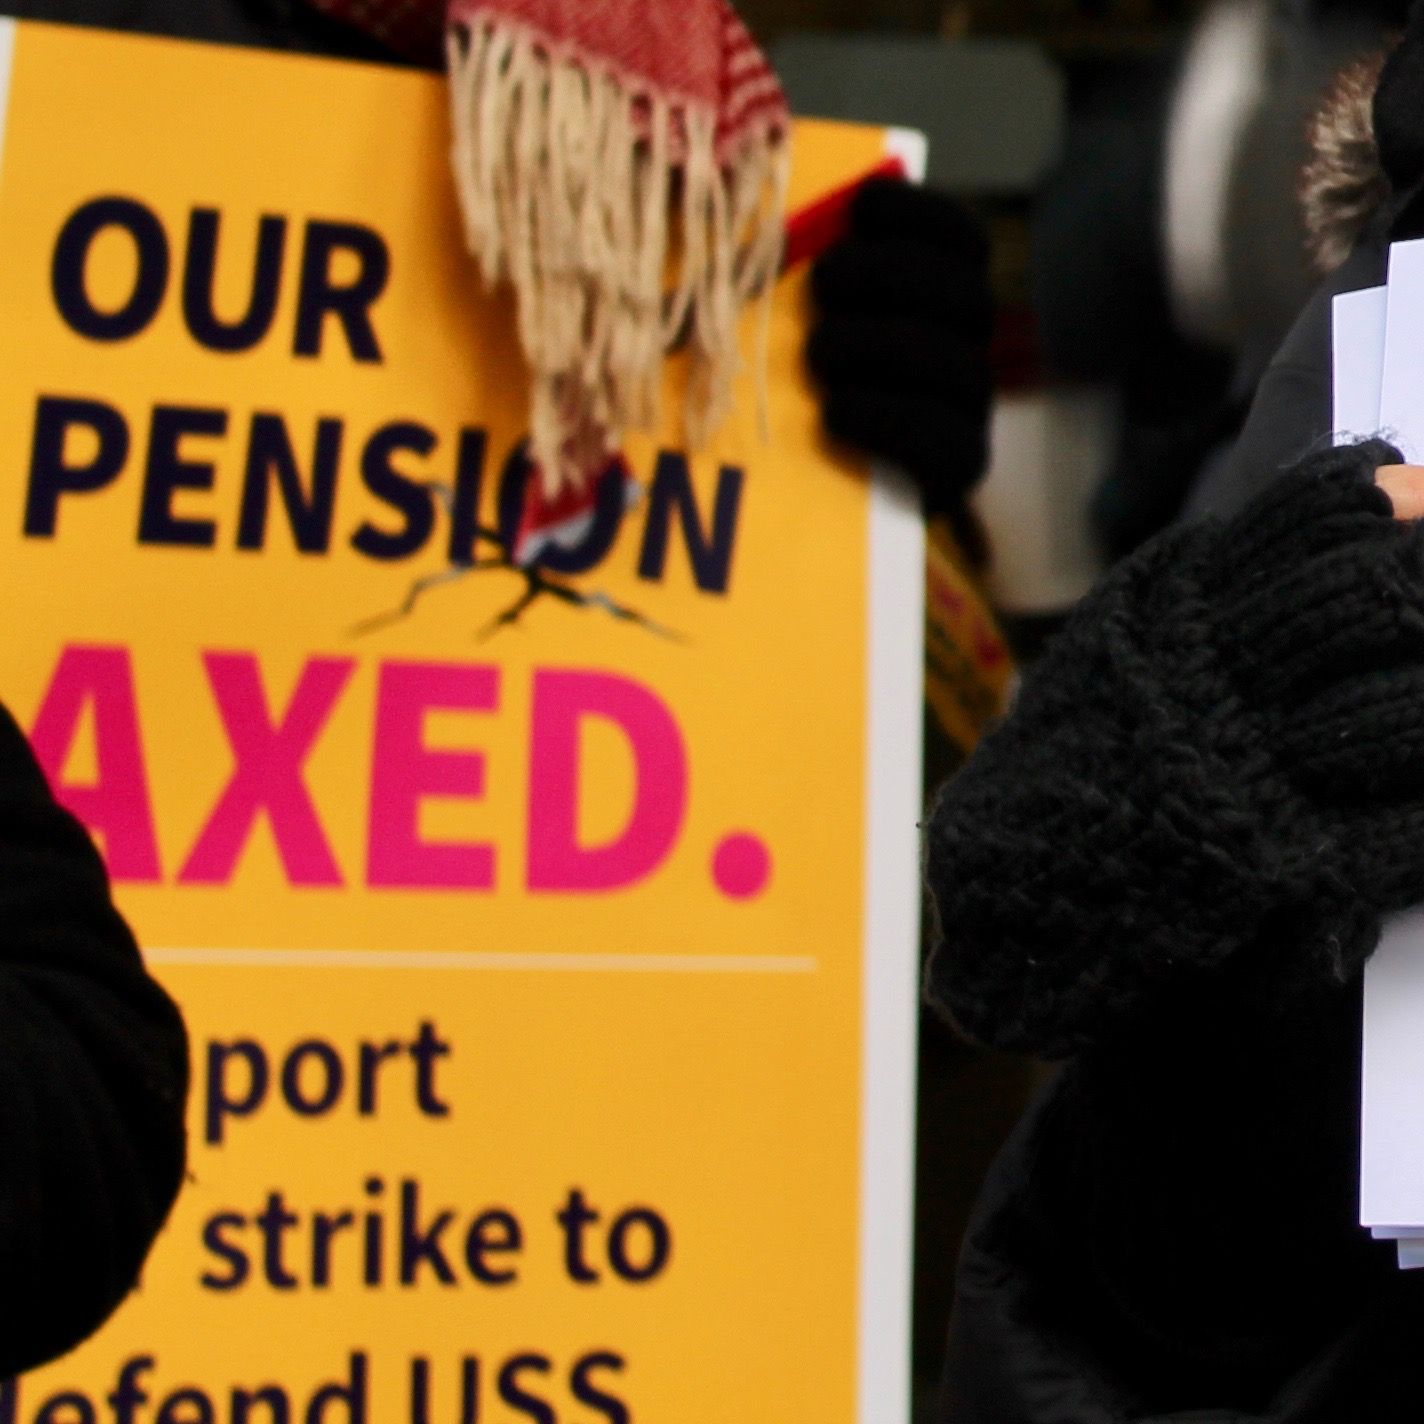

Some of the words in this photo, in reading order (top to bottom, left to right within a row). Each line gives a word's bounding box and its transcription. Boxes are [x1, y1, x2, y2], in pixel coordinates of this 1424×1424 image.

[51, 196, 390, 364] OUR
[23, 396, 743, 594] PENSION
[18, 644, 772, 900] AXED.
[206, 1022, 450, 1145] port
[202, 1178, 522, 1291] strike
[556, 1190, 671, 1284] to
[411, 1352, 631, 1424] USS
